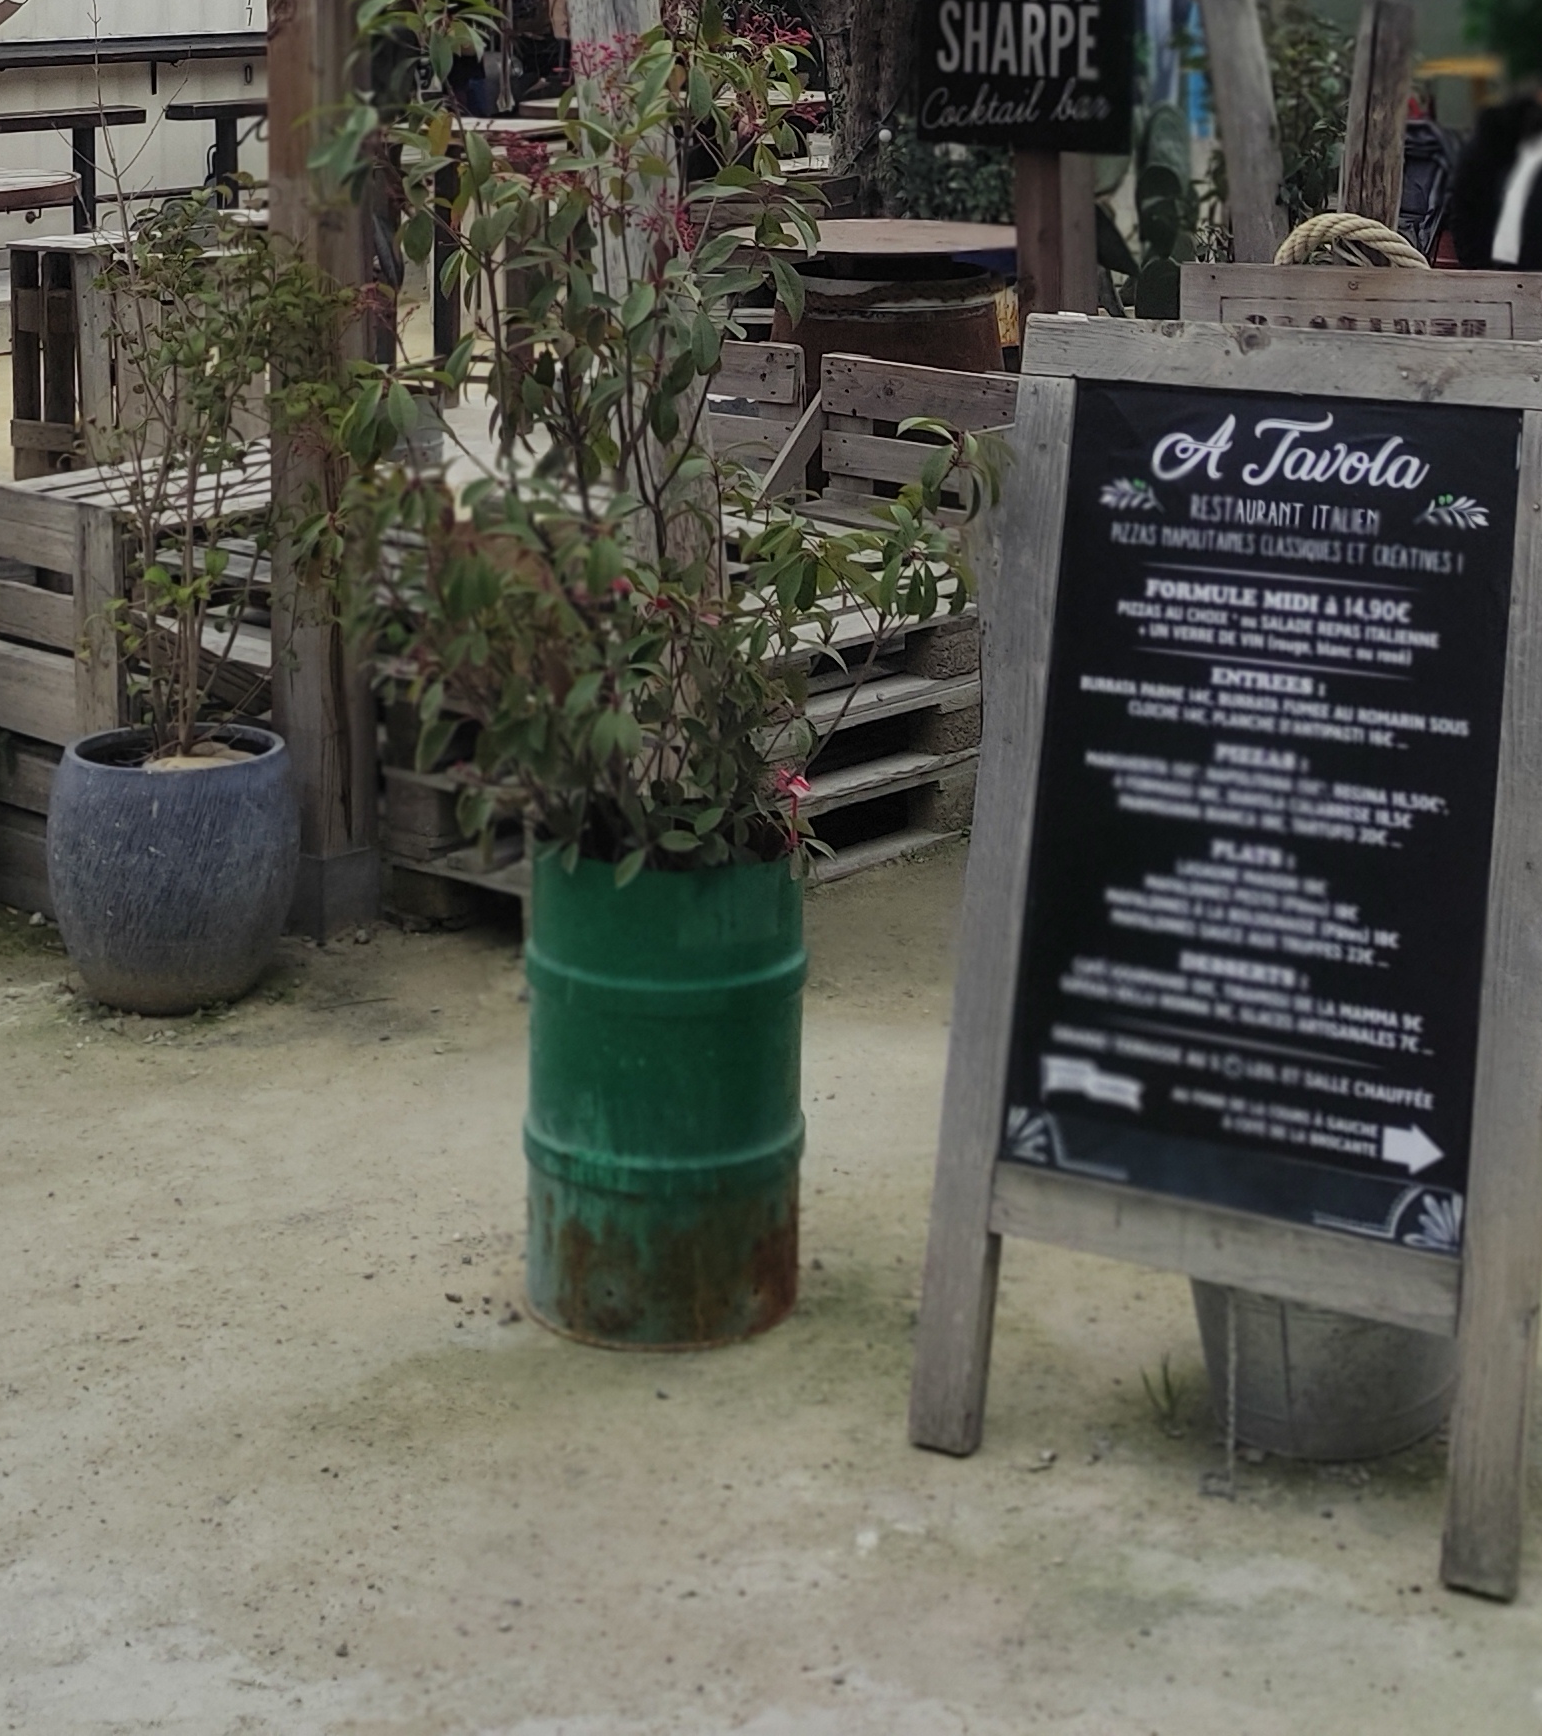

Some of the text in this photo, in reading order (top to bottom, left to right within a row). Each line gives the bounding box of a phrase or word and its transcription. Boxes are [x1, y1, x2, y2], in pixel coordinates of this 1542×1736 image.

[937, 1, 1100, 80] SHARPE
[921, 79, 1043, 129] Cocktail
[1152, 412, 1430, 489] A Tavola
[1190, 494, 1381, 536] RESTAURANT ITALIEN
[1111, 521, 1157, 547] PIZZAS
[1260, 533, 1342, 563] CLASSIQUES
[1346, 541, 1368, 565] ET
[1145, 578, 1257, 608] FORMULE
[1263, 590, 1319, 614] MIDI
[1345, 595, 1412, 624] 14,90€
[1118, 600, 1161, 619] PIZZAS
[1164, 605, 1184, 622] AU
[1261, 614, 1314, 635] SALADE
[1317, 620, 1361, 640] REPAS
[1365, 624, 1440, 650] ITALIENNE
[1173, 625, 1214, 644] VERRE
[1218, 630, 1235, 647] DE
[1240, 631, 1264, 650] VIN
[1211, 666, 1314, 697] ENTREES
[1357, 707, 1426, 732] ROMARIN
[1429, 715, 1470, 738] SOUS
[1303, 1068, 1350, 1097] SALLE
[1353, 1077, 1436, 1112] CHAUFFÉE
